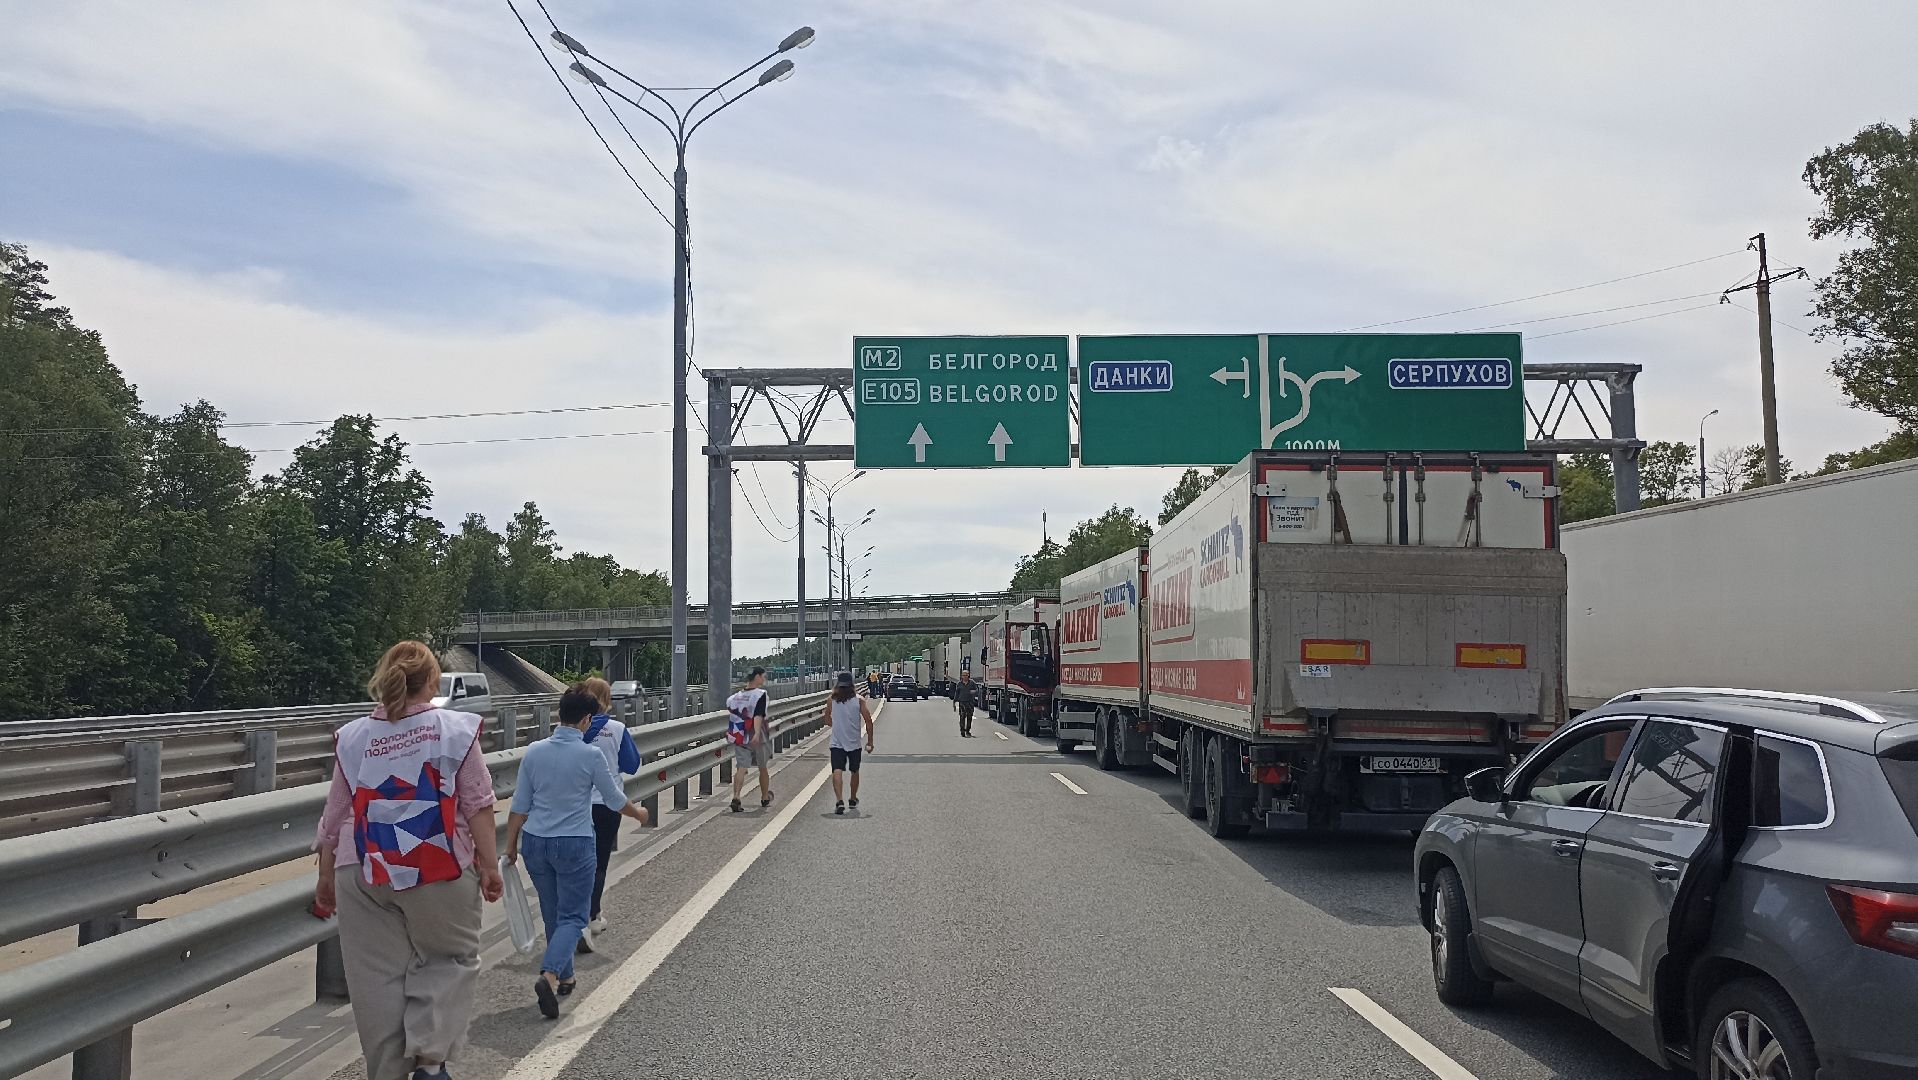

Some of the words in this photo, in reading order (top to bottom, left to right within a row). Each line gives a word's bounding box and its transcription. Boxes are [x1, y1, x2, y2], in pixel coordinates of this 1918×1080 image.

[866, 350, 897, 366] М2
[929, 354, 1058, 371] БЕЛГОРОД
[1095, 366, 1168, 389] ДАНКИ
[1394, 364, 1507, 383] СЕРПУХОВ
[866, 383, 916, 400] E105
[930, 385, 1058, 403] BELGOROD
[1152, 565, 1193, 632] МАГНИТ
[1063, 603, 1100, 645] МАГНИТ
[364, 733, 441, 758] ПОДМОСКОВЬЯ
[371, 725, 436, 748] ВОЛОНТЕРЫ
